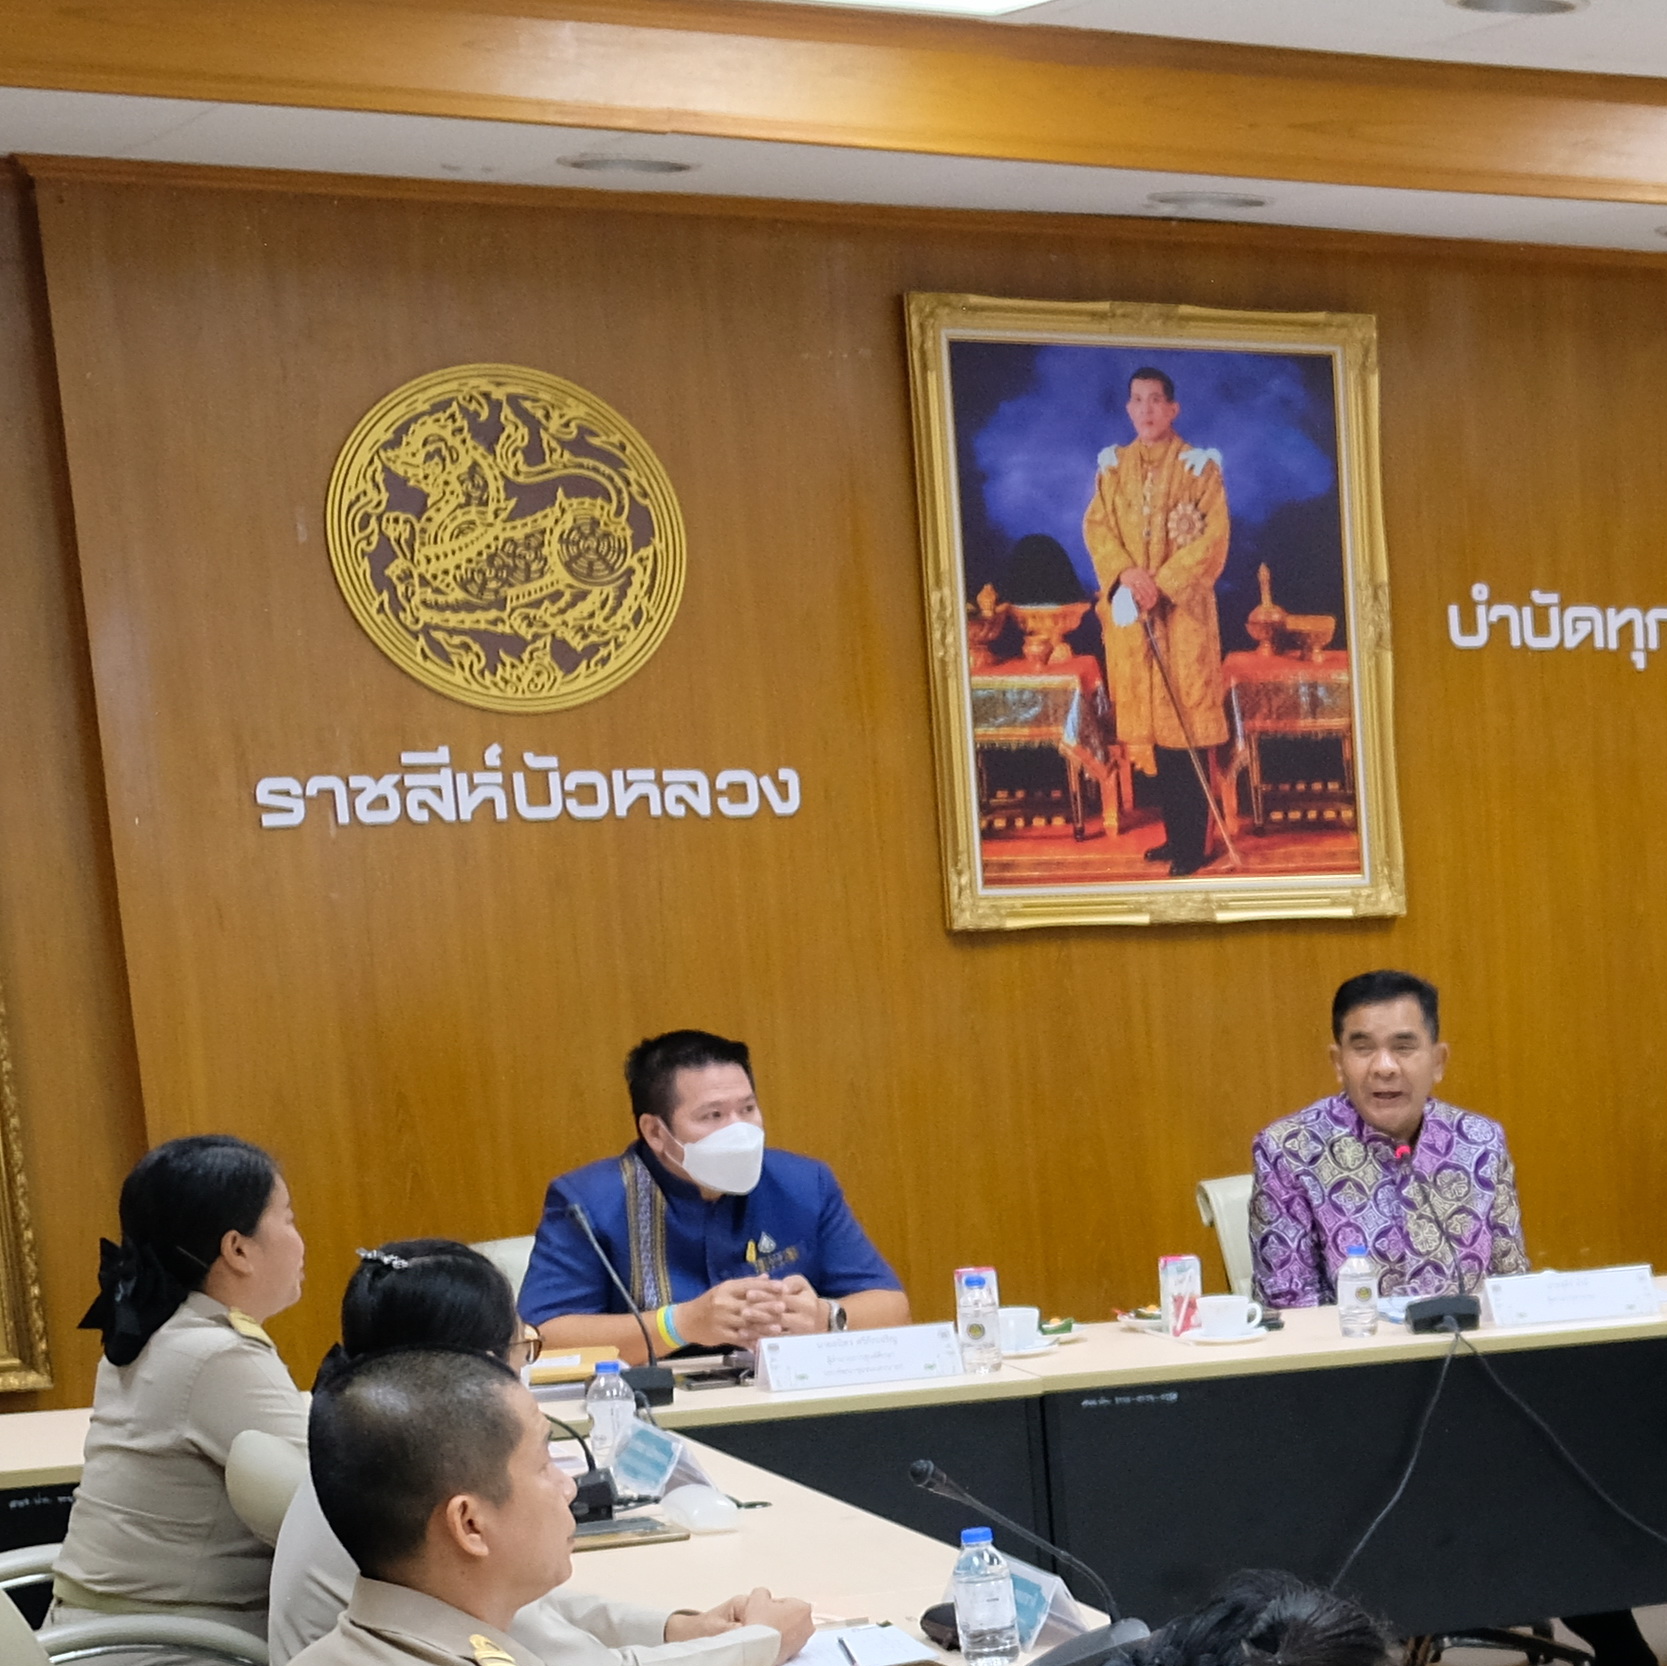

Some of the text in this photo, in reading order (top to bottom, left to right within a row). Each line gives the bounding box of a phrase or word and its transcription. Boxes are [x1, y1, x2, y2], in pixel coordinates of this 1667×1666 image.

[256, 743, 801, 828] ราชสีห์บัวหลวง
